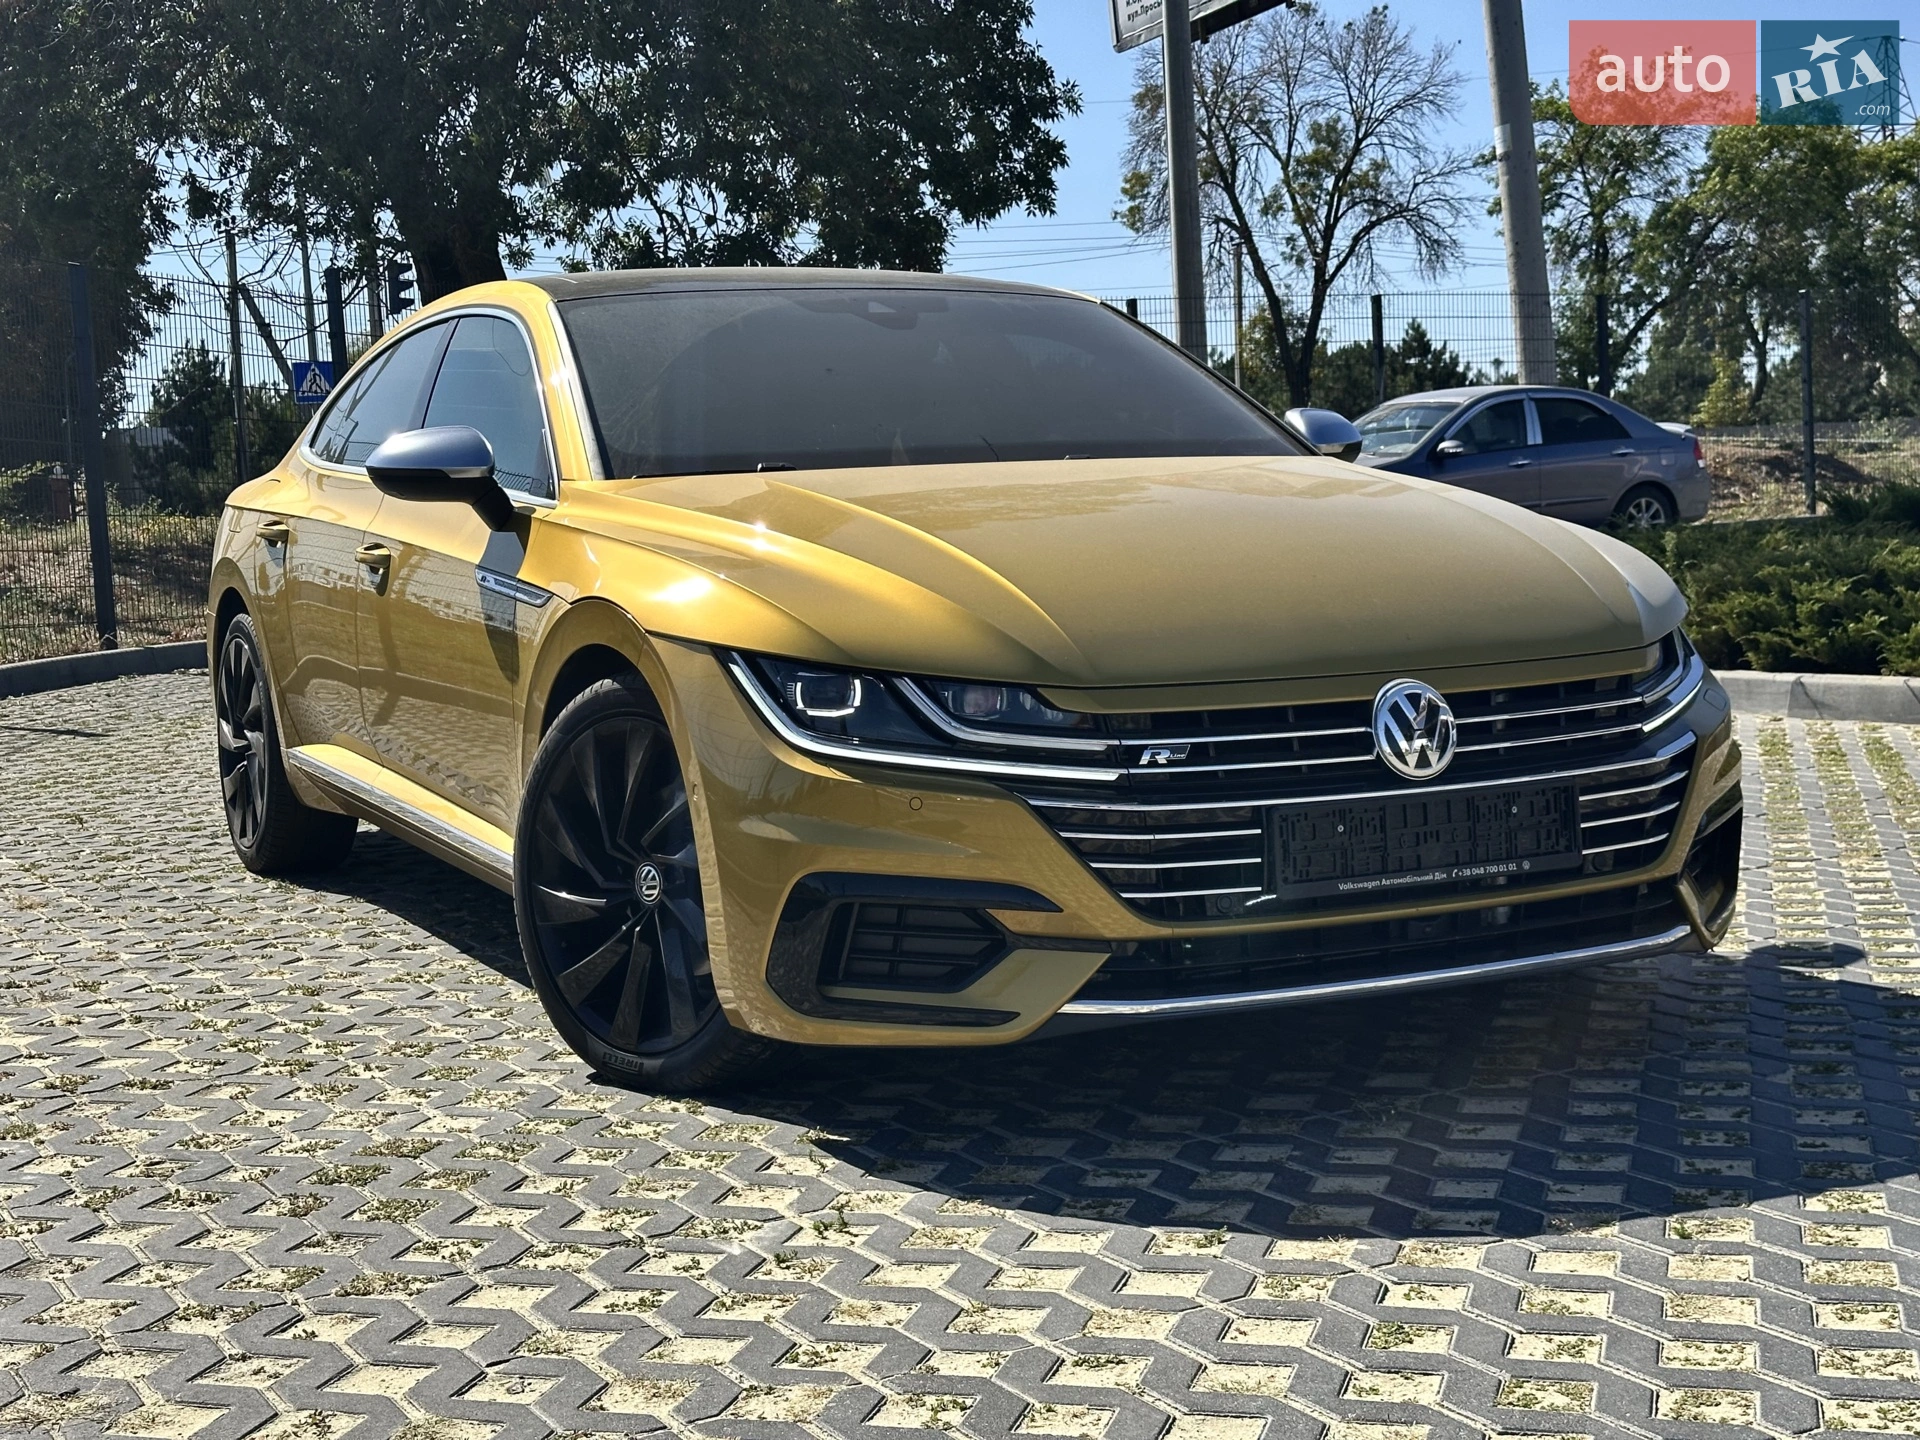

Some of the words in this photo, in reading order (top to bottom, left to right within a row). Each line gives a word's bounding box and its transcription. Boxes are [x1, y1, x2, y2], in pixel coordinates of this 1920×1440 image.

[1338, 879, 1380, 890] Volkswagen
[1381, 873, 1434, 886] Автомобільний
[1434, 871, 1448, 880] Дім
[1458, 867, 1471, 876] +38
[1471, 866, 1485, 875] 048
[1486, 865, 1498, 874] 700
[1499, 864, 1508, 872] 01
[1508, 863, 1518, 871] 01
